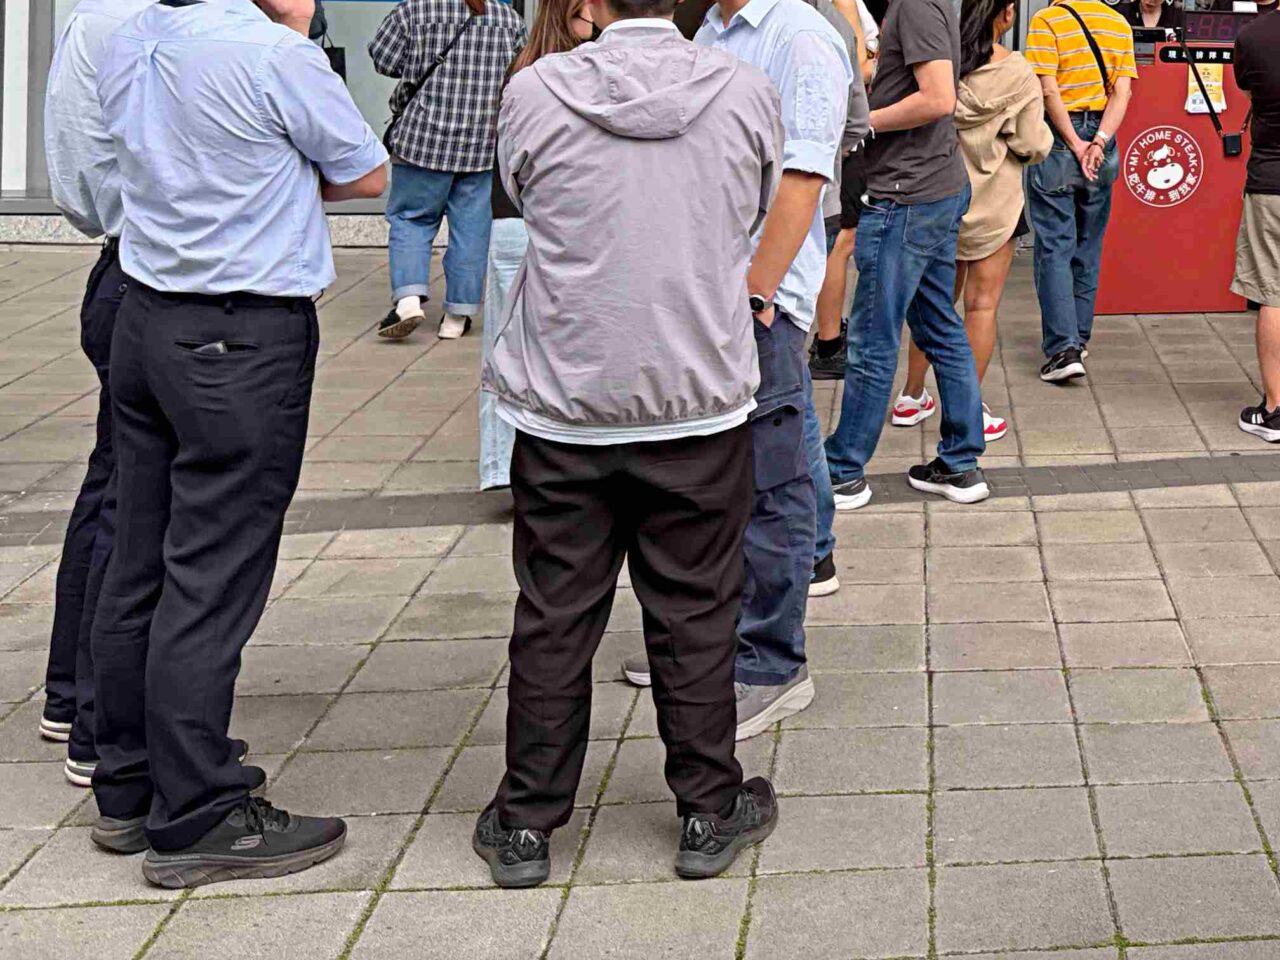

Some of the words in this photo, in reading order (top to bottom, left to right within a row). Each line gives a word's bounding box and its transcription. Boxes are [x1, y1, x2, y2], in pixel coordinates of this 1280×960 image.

[1128, 147, 1141, 166] MY
[1138, 130, 1172, 149] HOME
[1174, 134, 1198, 168] STEAK
[1128, 172, 1157, 202] 吃牛排
[1167, 172, 1198, 202] 到我家
